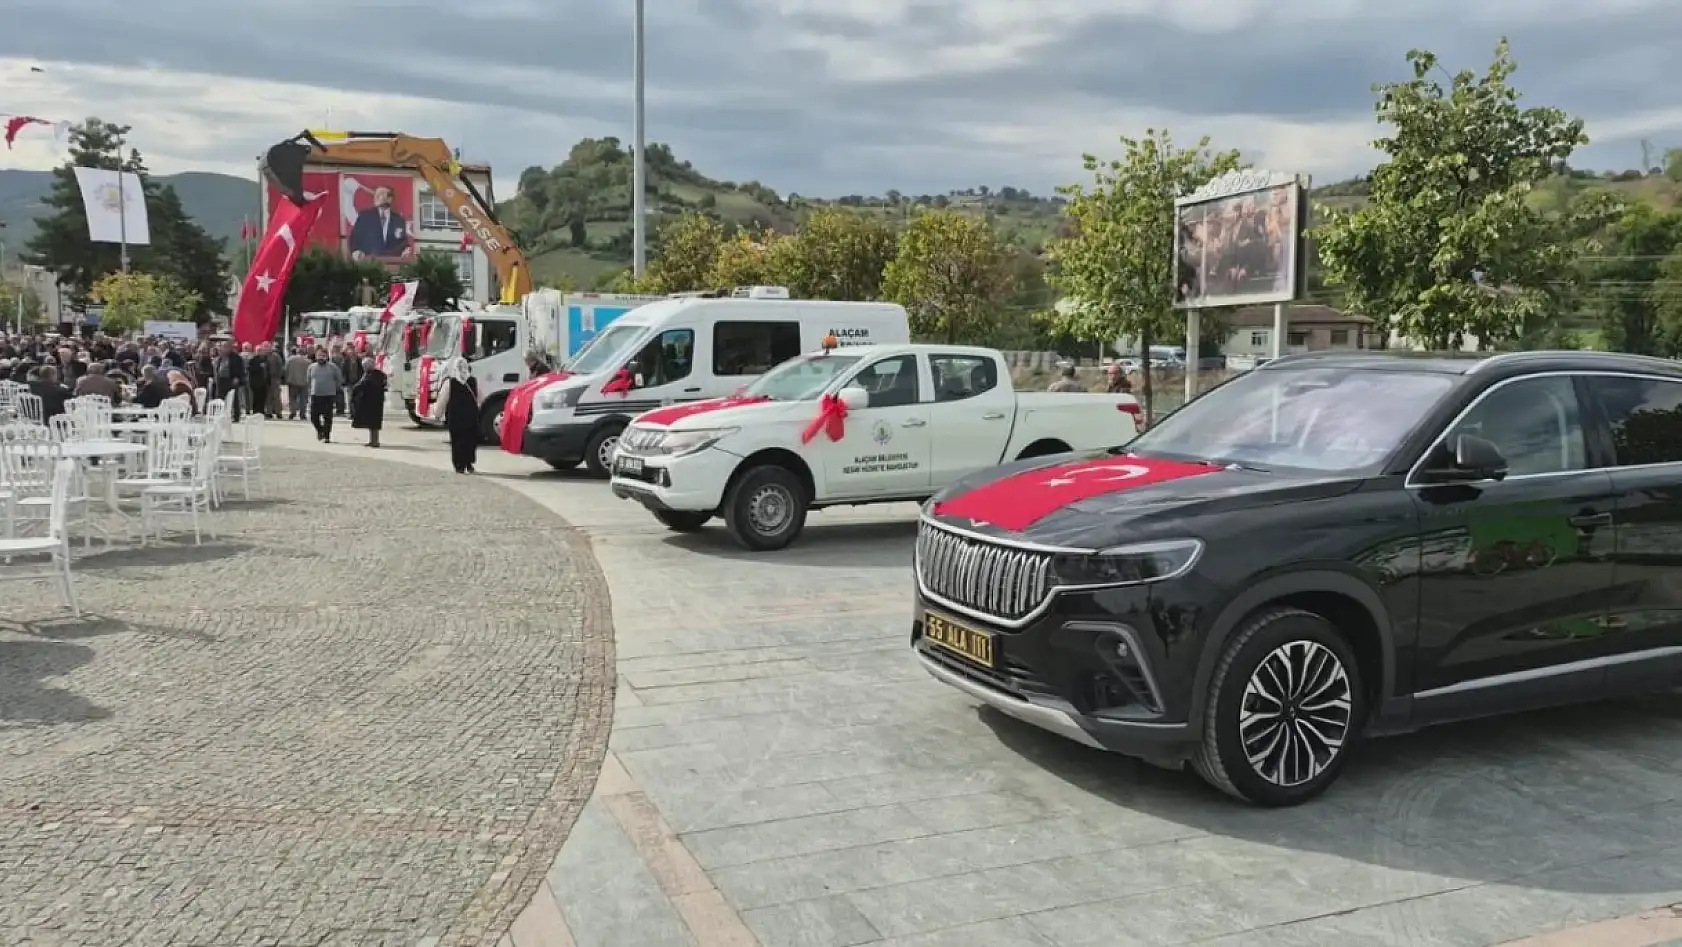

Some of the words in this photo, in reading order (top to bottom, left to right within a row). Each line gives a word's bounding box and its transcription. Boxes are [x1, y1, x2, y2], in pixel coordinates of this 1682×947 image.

[458, 205, 501, 251] CASE
[829, 327, 870, 338] ALAÇAM
[948, 624, 967, 650] ALA
